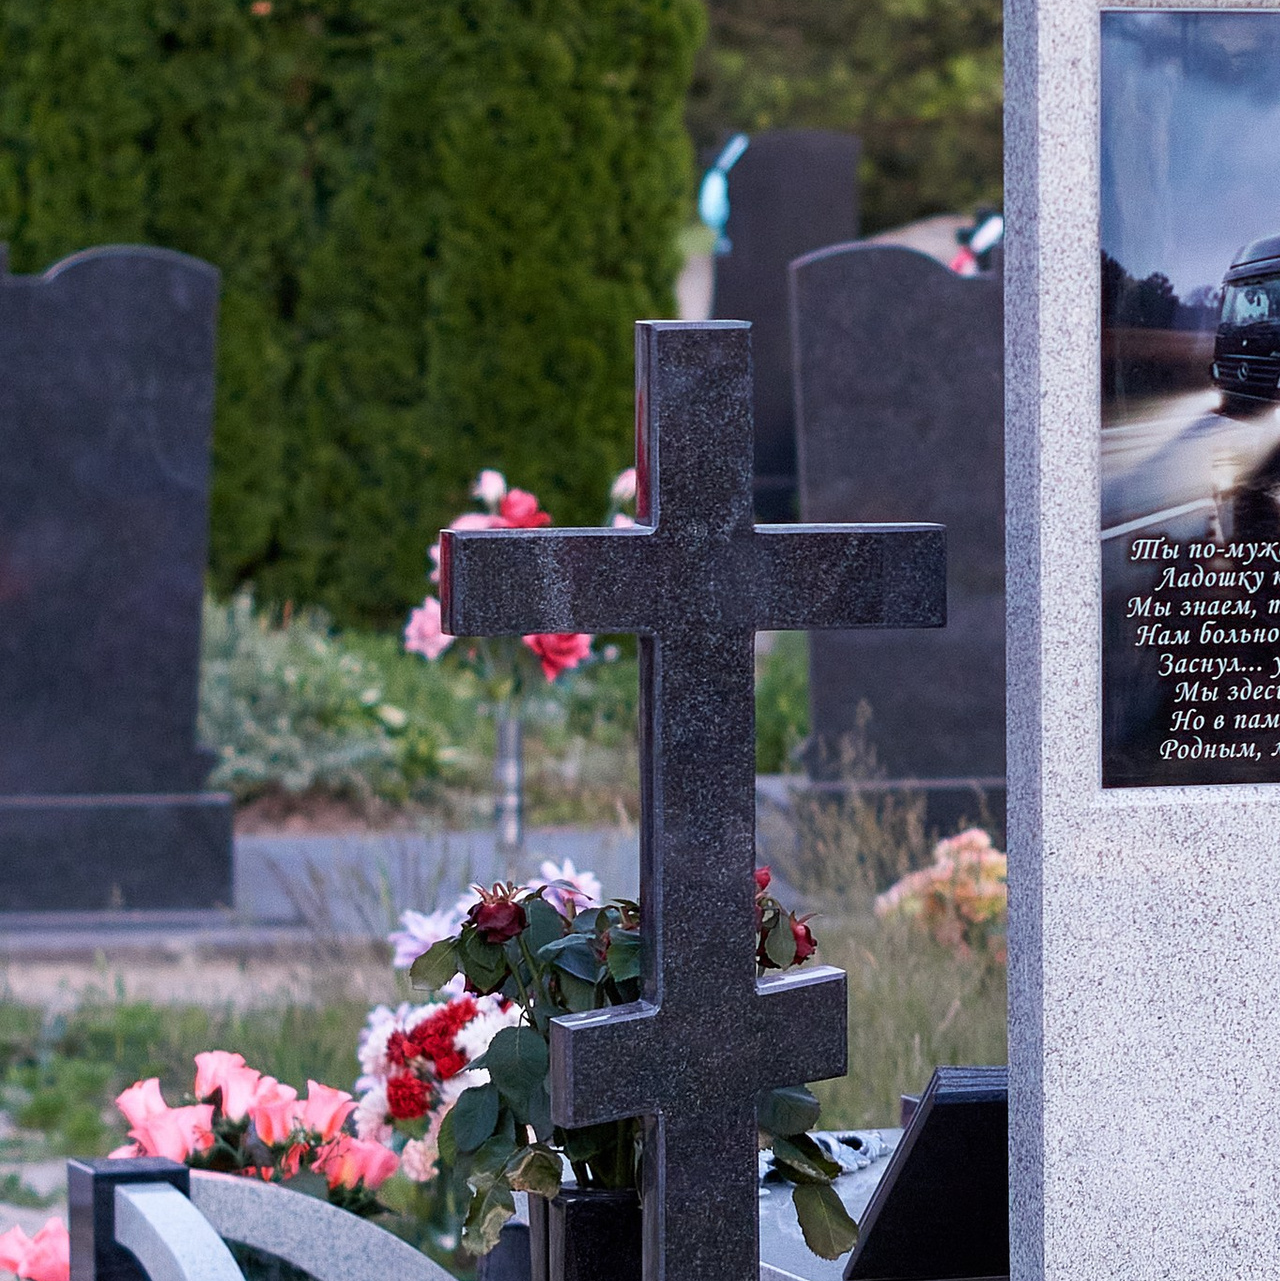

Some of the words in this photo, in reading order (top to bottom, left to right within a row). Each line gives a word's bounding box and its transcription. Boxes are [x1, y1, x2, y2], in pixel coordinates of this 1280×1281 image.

[1130, 536, 1180, 561] Ты
[1154, 563, 1265, 594] Ладошку
[1126, 595, 1172, 618] Мы
[1179, 599, 1257, 619] знаем,
[1134, 623, 1191, 647] Нам
[1199, 620, 1280, 645] больно
[1157, 653, 1263, 681] Заснул...
[1173, 680, 1219, 703] Мы
[1169, 708, 1205, 732] Но
[1213, 714, 1225, 730] в
[1159, 735, 1262, 762] Родным,
